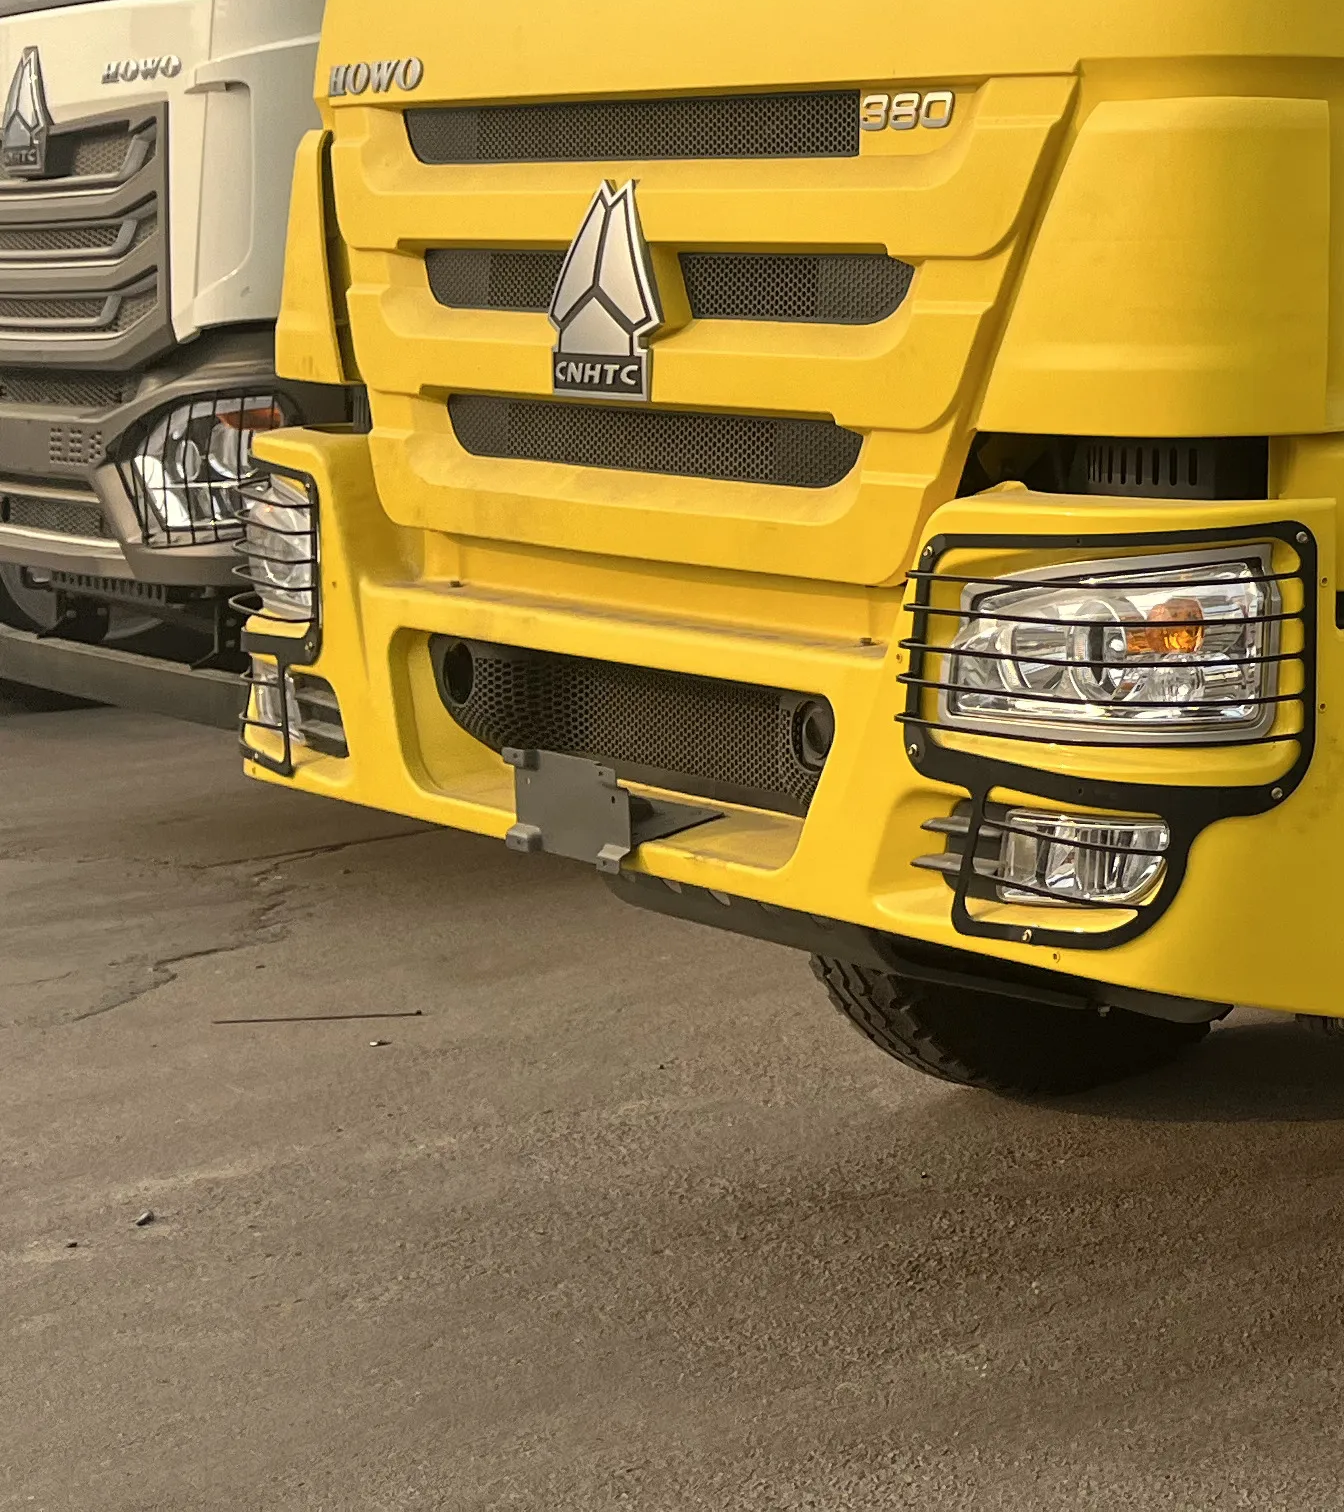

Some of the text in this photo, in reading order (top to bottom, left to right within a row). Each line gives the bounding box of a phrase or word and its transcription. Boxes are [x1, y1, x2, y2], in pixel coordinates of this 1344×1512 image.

[101, 54, 182, 85] HOWO
[328, 56, 424, 97] HOWO
[859, 90, 955, 132] 380
[555, 360, 640, 385] CNHTC
